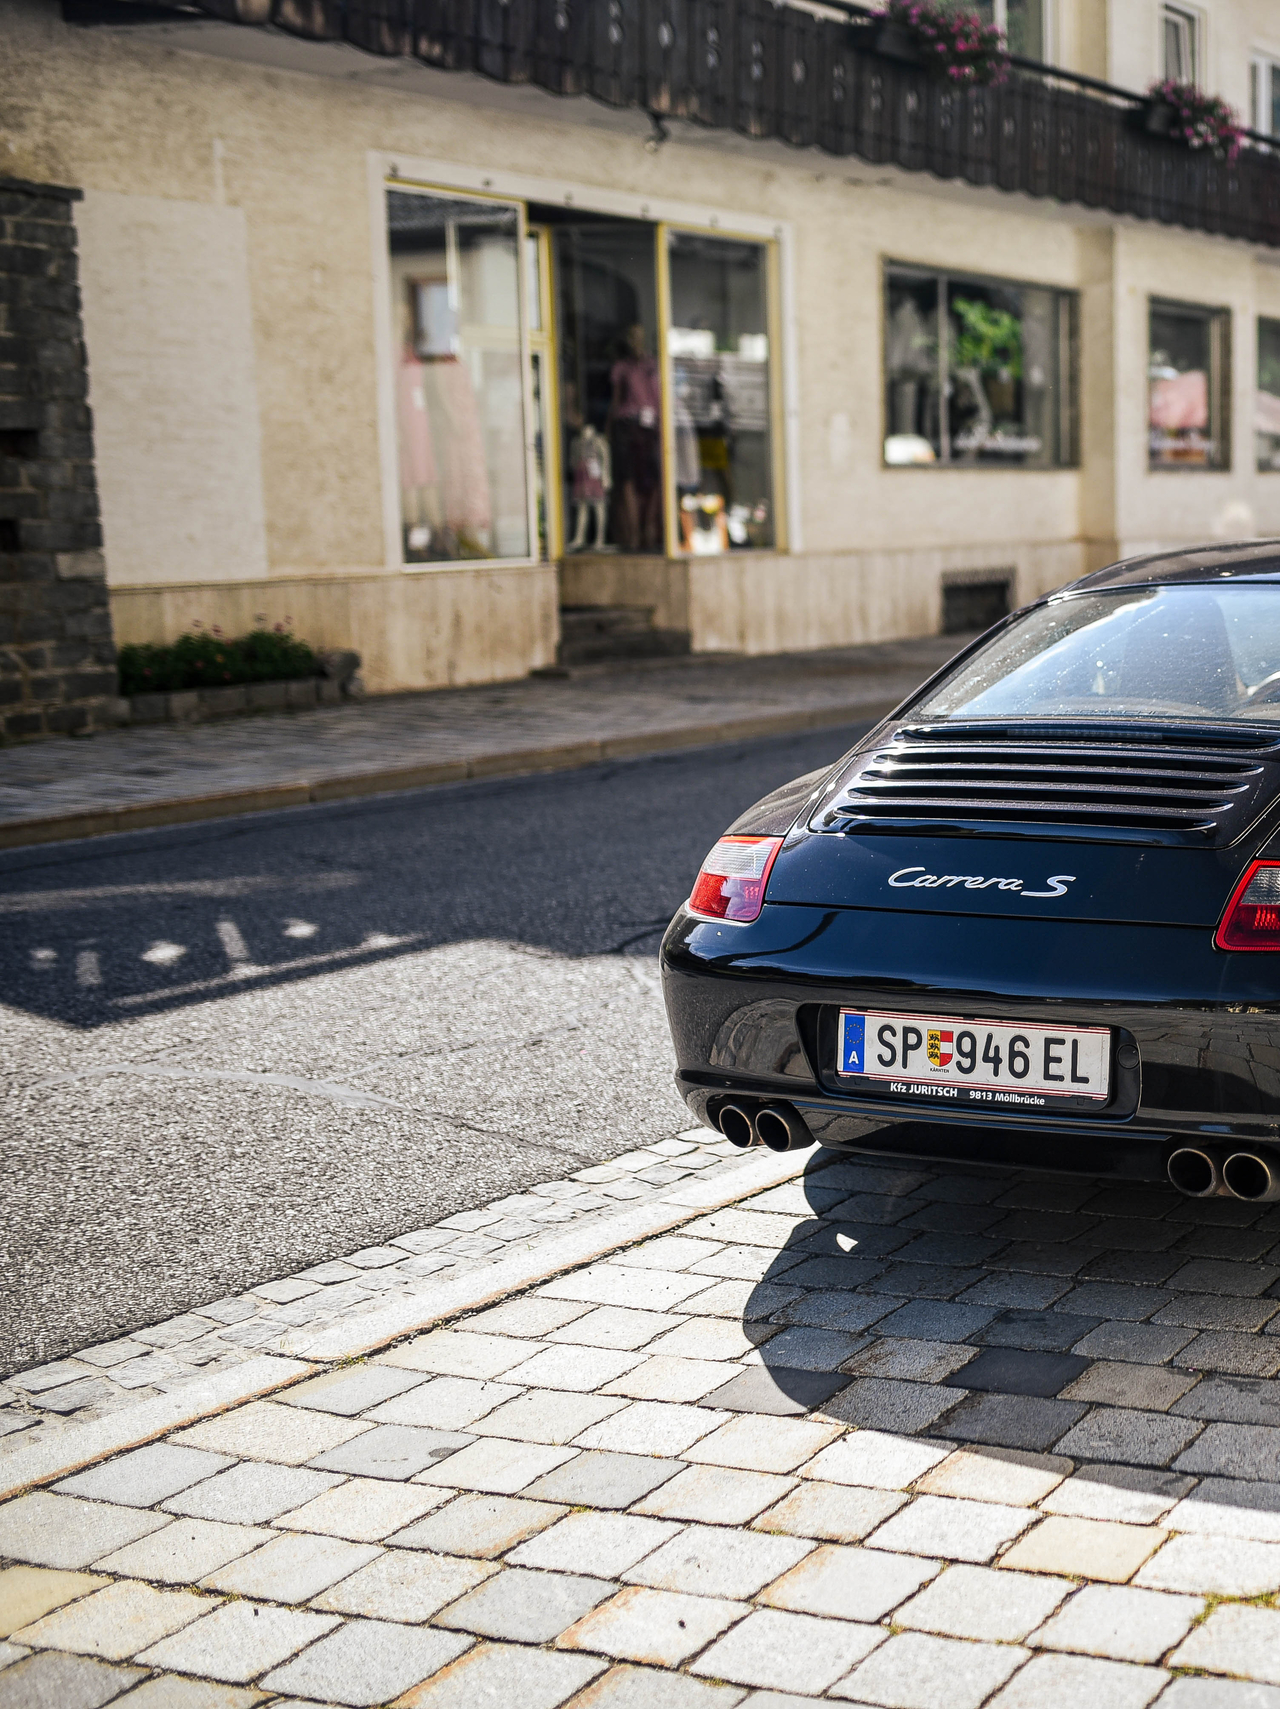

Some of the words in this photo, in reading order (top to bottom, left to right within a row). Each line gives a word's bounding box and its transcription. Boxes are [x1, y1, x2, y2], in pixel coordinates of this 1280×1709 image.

[888, 867, 1024, 890] Carrera
[1020, 875, 1076, 897] S
[848, 1051, 859, 1064] A
[877, 1024, 923, 1070] SP
[956, 1030, 1029, 1079] 946
[1043, 1037, 1090, 1084] EL
[890, 1082, 907, 1093] Kfz
[909, 1084, 958, 1097] JURITSCH
[969, 1090, 993, 1101] 9813
[994, 1093, 1045, 1106] Möllbrücke
